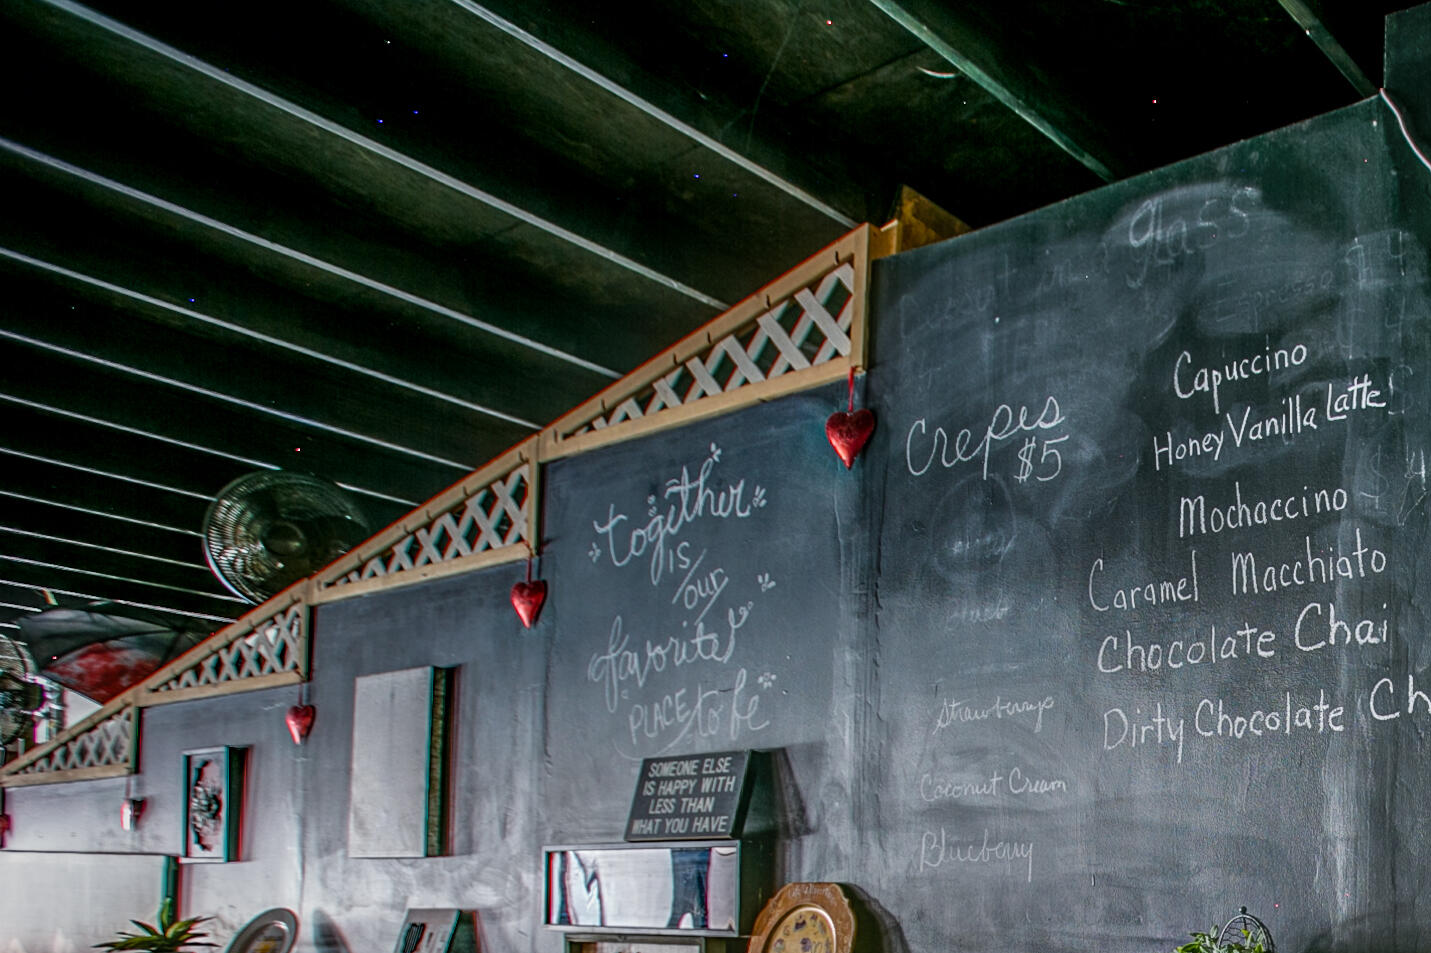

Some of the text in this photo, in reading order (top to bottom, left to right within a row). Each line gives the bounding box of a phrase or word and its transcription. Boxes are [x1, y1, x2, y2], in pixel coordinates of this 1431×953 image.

[1173, 343, 1308, 415] Capuccino
[906, 396, 1066, 480] Crepes
[1154, 430, 1225, 472] Honey
[1226, 394, 1318, 447] Vanilla
[1326, 373, 1388, 422] Latte
[1012, 435, 1070, 483] $5
[1179, 481, 1348, 538] Mochaccino
[1088, 528, 1387, 612] Caramel Macchiato
[1097, 602, 1389, 674] Chocolate Chai
[629, 687, 693, 745] PLACE
[1103, 702, 1185, 764] Dirty
[1194, 689, 1345, 740] Chocolate
[642, 776, 736, 797] IS HAPPY WITH
[648, 756, 732, 778] SOMEONE ELSE
[919, 766, 1067, 802] Coconut Cream
[631, 816, 729, 835] WHAT YOU HAVE
[648, 797, 715, 815] LESS THAN
